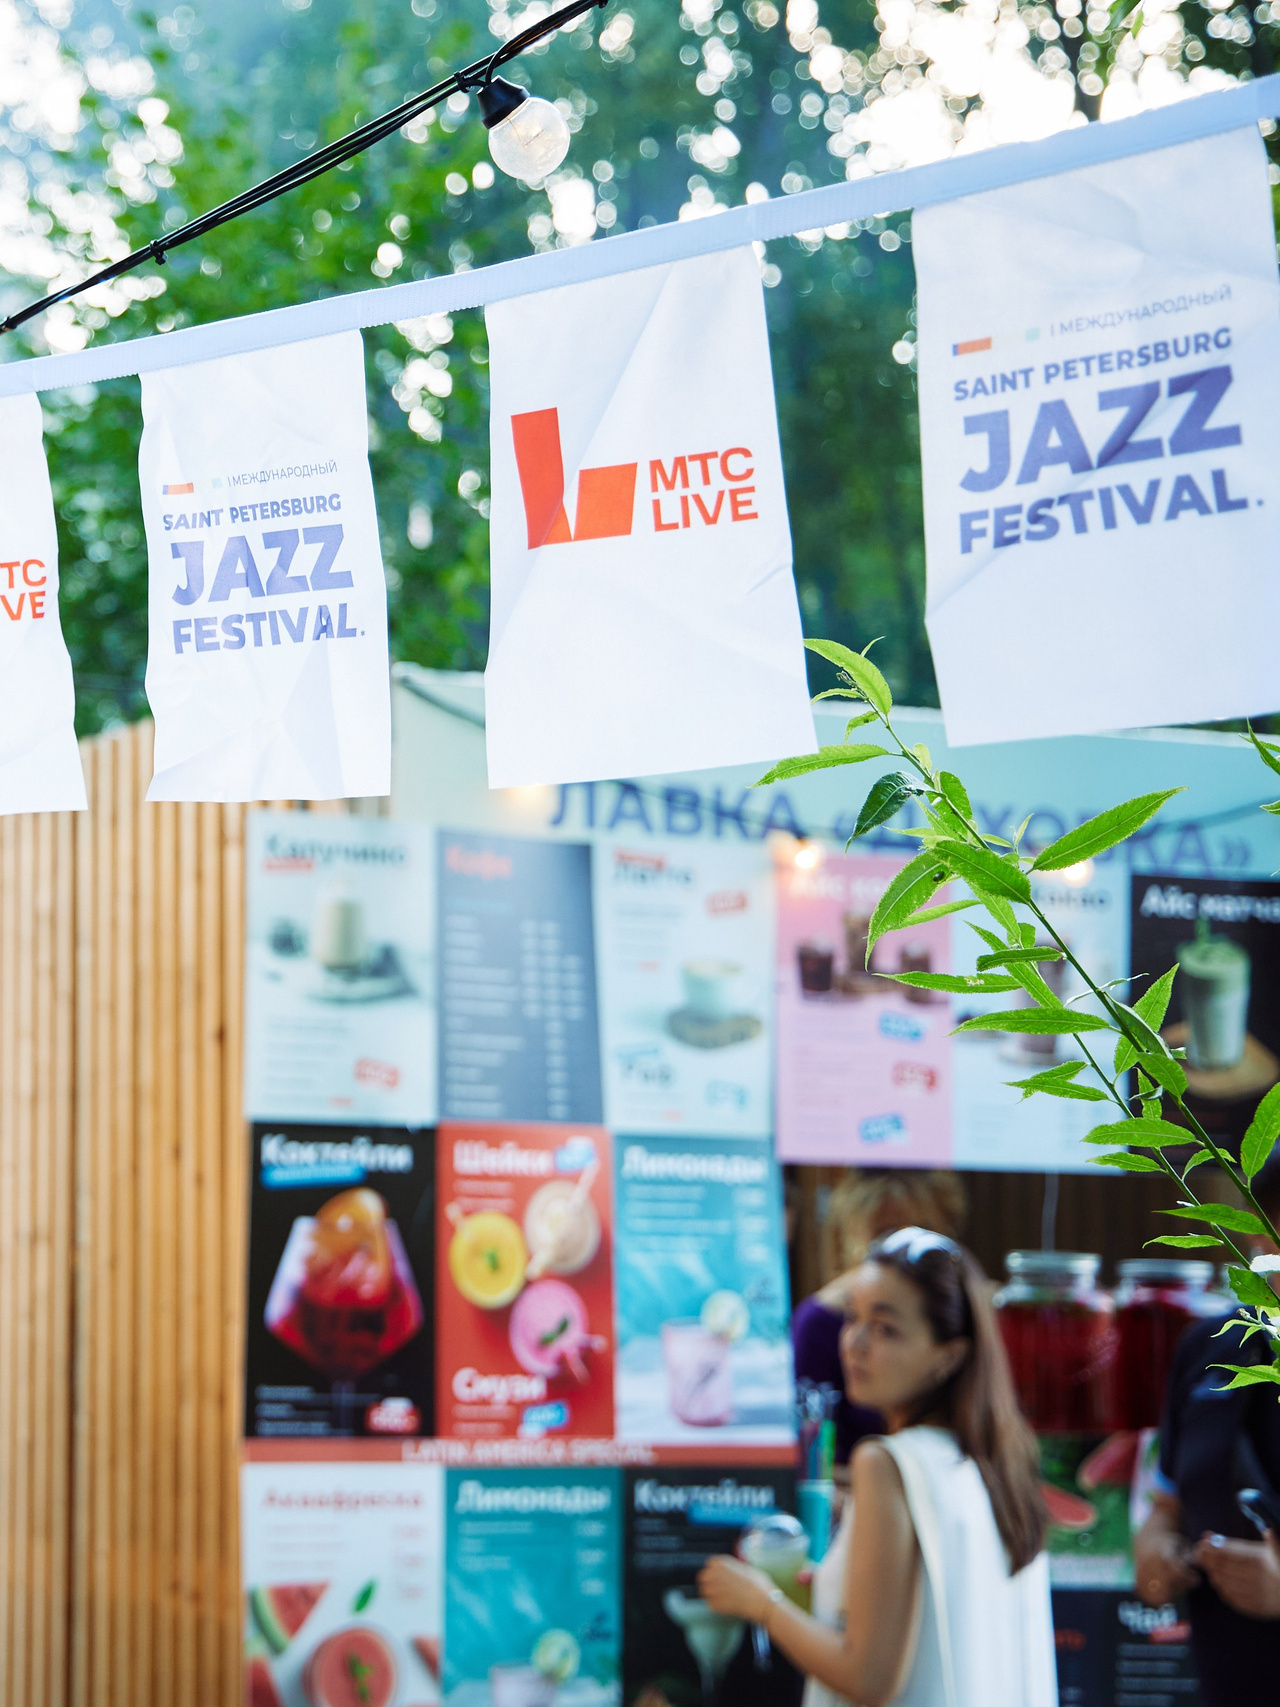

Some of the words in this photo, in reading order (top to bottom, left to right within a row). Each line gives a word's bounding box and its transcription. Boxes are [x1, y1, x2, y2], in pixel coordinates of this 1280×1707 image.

[1060, 285, 1233, 335] МЕЖДУНАРОДНЫЙ
[953, 367, 1035, 402] SAINT
[1044, 327, 1234, 385] PETERSBURG
[958, 364, 1243, 493] JAZZ
[233, 459, 338, 486] МЕЖДУНАРОДНЫЙ
[163, 508, 224, 531] SAINT
[229, 493, 342, 524] PETERSBURG
[651, 486, 759, 532] LIVE
[170, 523, 355, 605] JAZZ
[551, 780, 809, 841] ЛАВКА
[1139, 883, 1198, 920] Айс
[260, 1133, 414, 1174] Коктейли
[452, 1366, 547, 1410] Смузи
